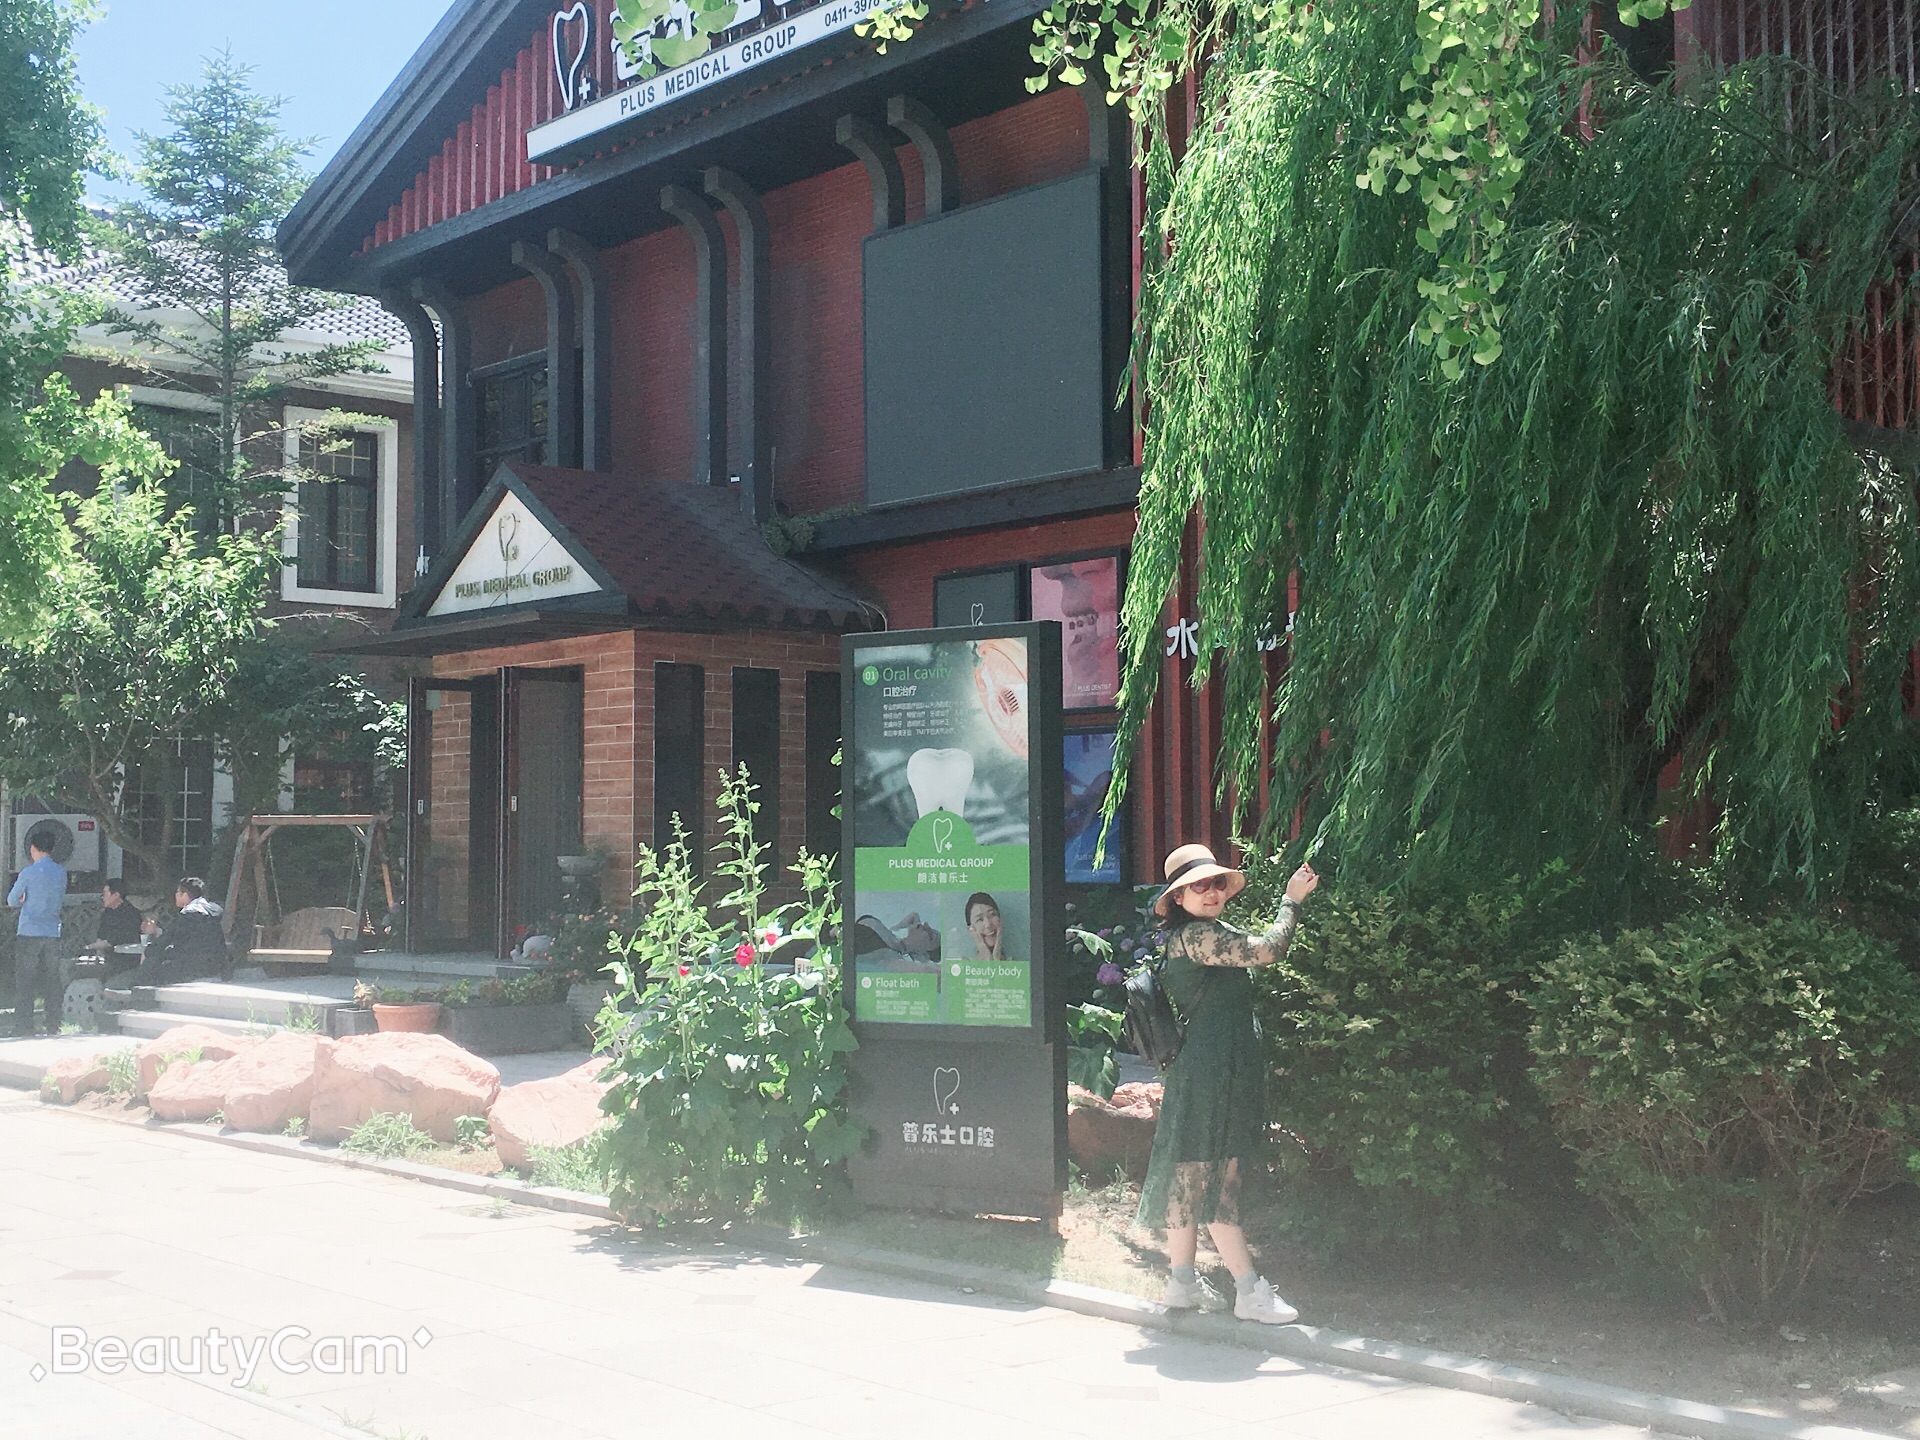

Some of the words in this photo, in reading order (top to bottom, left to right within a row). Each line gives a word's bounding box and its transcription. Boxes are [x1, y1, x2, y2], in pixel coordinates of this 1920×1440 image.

[620, 86, 655, 115] PLUS
[665, 55, 731, 96] MEDICAL
[741, 26, 796, 63] GROUP
[455, 581, 480, 598] PLUS
[483, 573, 528, 594] MEDICAL
[533, 566, 571, 587] GROUP
[865, 671, 875, 680] 01
[882, 666, 909, 681] Oral
[914, 665, 951, 679] cavity
[883, 685, 917, 697] 口腔治疗
[888, 859, 913, 868] PLUS
[916, 858, 958, 868] MEDICAL
[959, 858, 994, 868] GROUP
[965, 965, 996, 978] Beauty
[998, 965, 1022, 978] body
[875, 977, 897, 988] Float
[900, 977, 920, 988] bath
[902, 1121, 994, 1148] 普乐士口腔
